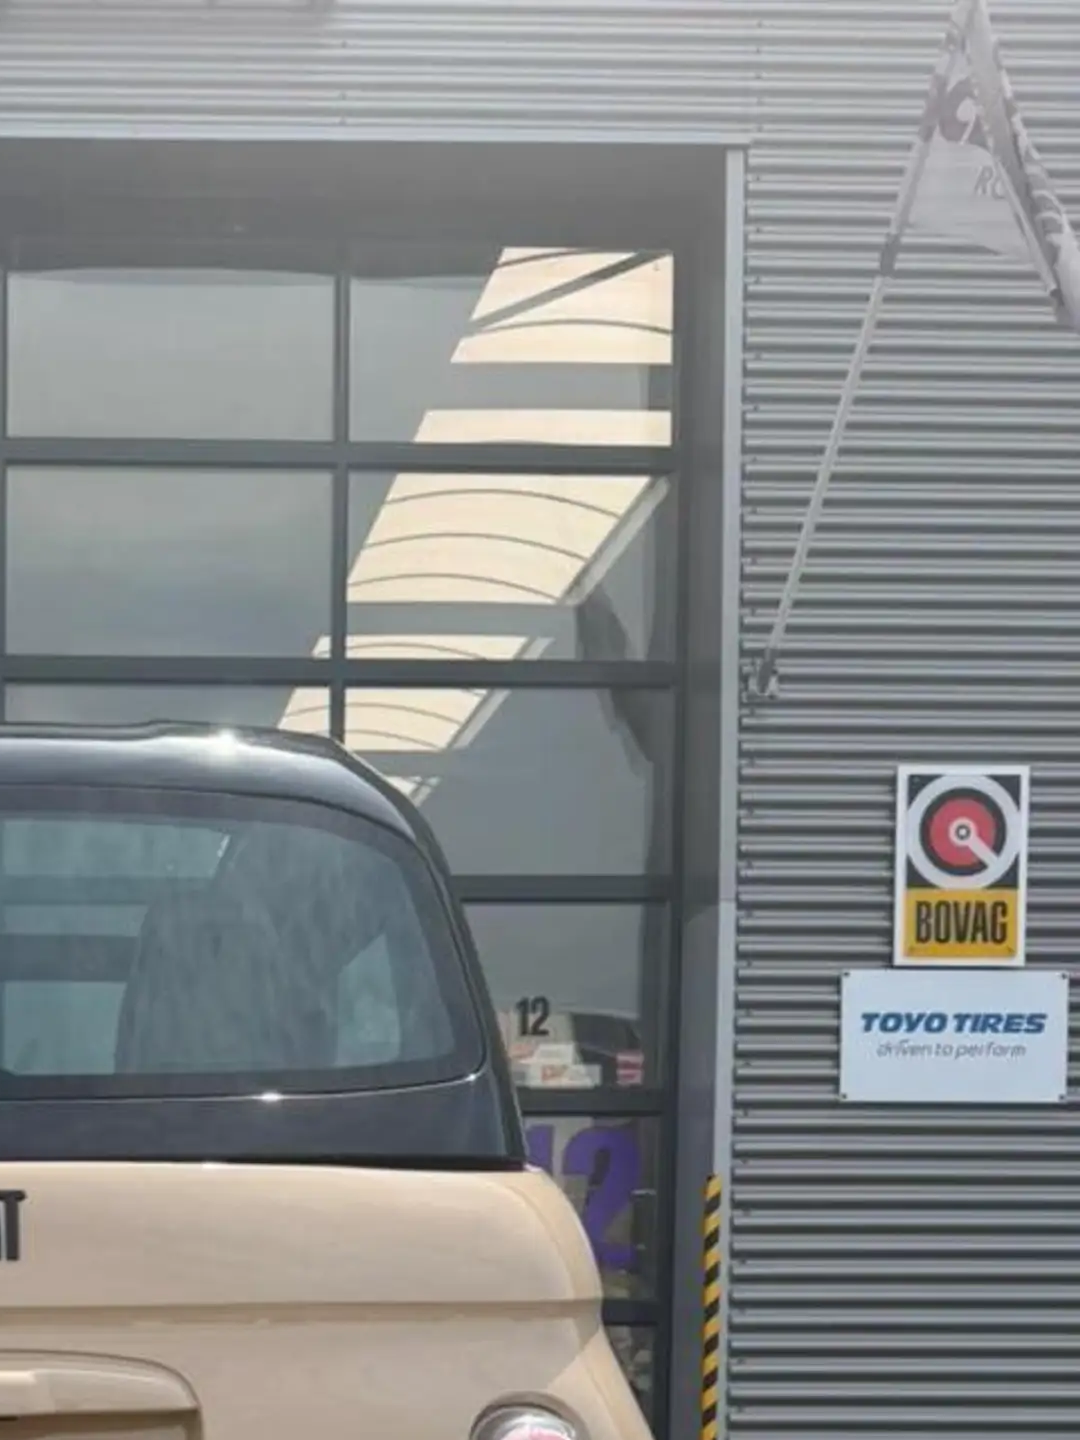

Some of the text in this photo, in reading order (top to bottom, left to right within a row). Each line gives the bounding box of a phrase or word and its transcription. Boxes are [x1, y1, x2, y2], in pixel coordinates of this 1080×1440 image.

[915, 900, 1009, 945] BOVAG
[515, 996, 550, 1037] 12
[861, 1012, 1048, 1035] TOYO TIRES
[877, 1040, 1027, 1061] driven to perform
